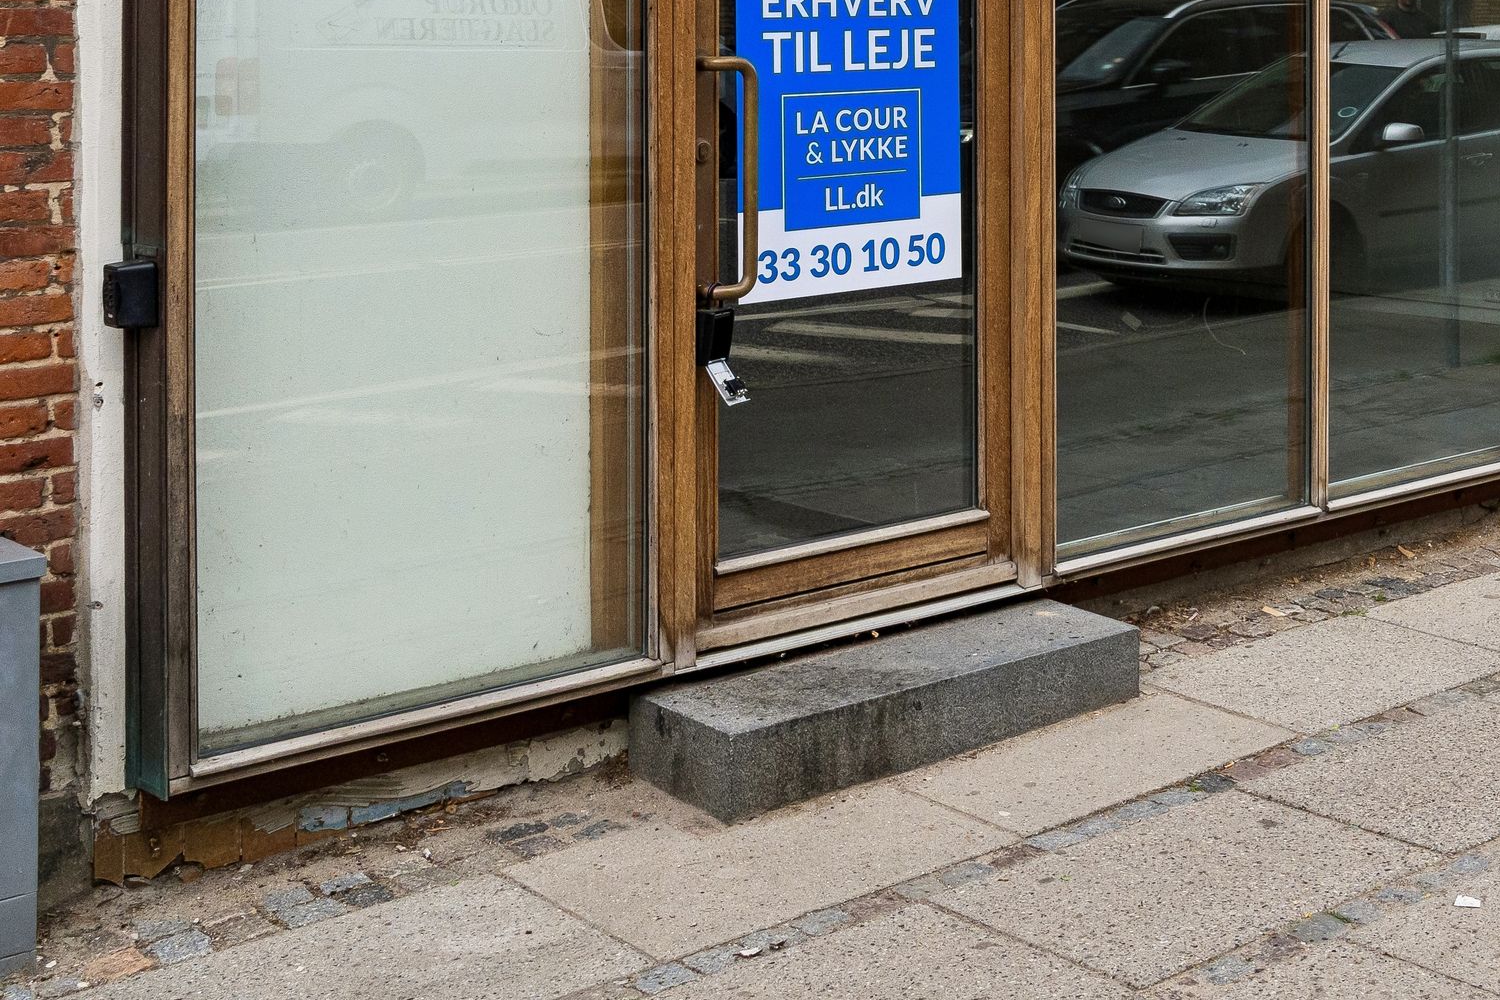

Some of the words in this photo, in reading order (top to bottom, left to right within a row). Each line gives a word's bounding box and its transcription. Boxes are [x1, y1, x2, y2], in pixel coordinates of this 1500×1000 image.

[762, 31, 832, 74] TIL
[844, 28, 936, 71] LEJE
[796, 110, 829, 135] LA
[835, 106, 908, 132] COUR
[805, 141, 824, 164] &
[831, 136, 908, 163] LYKKE
[825, 183, 884, 211] LL.dk
[758, 247, 801, 284] 33
[810, 242, 852, 278] 30
[861, 237, 899, 272] 10
[907, 232, 946, 267] 50
